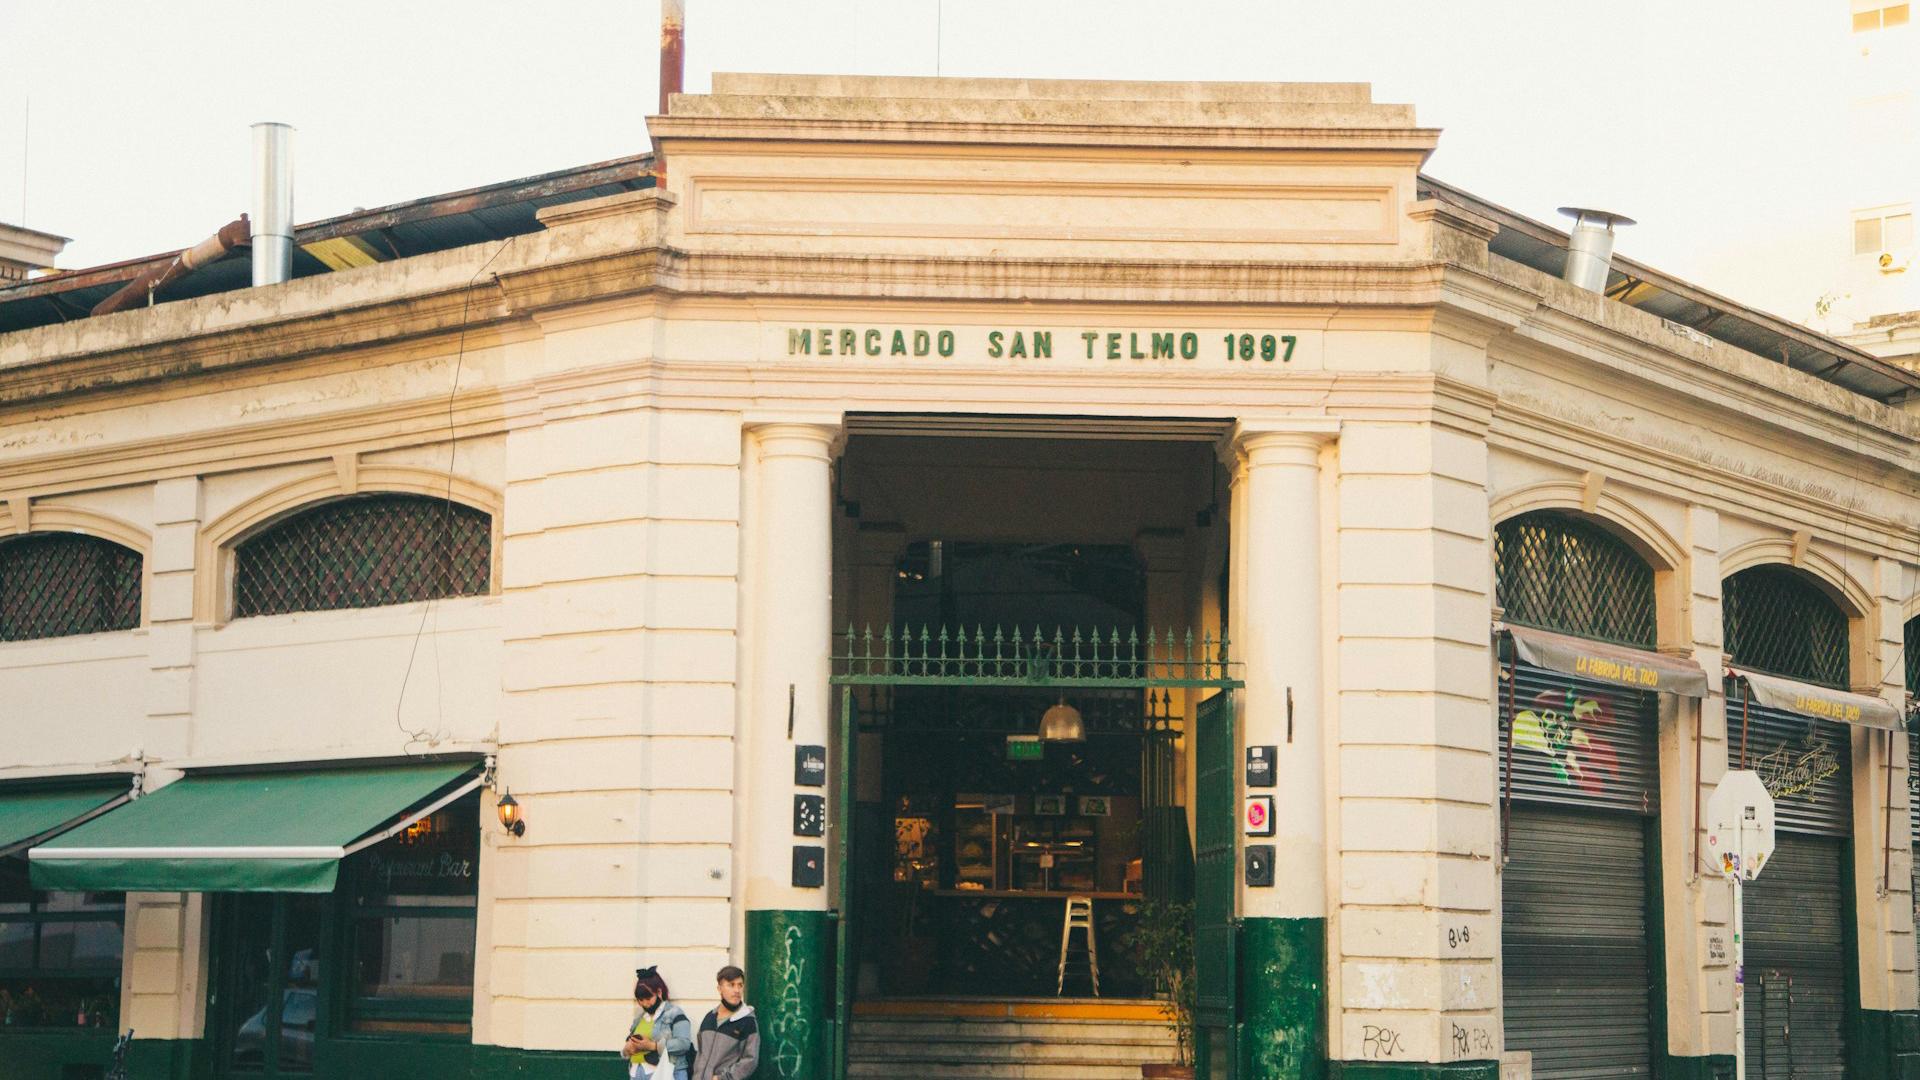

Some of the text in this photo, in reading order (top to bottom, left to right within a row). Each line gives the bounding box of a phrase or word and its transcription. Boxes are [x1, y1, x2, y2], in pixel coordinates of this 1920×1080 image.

[788, 328, 1297, 362] MERCADO SAN TELMO 1897
[1575, 656, 1587, 673] LA
[1622, 665, 1637, 683] DEL
[1639, 668, 1658, 687] TACO
[438, 851, 472, 878] Bar
